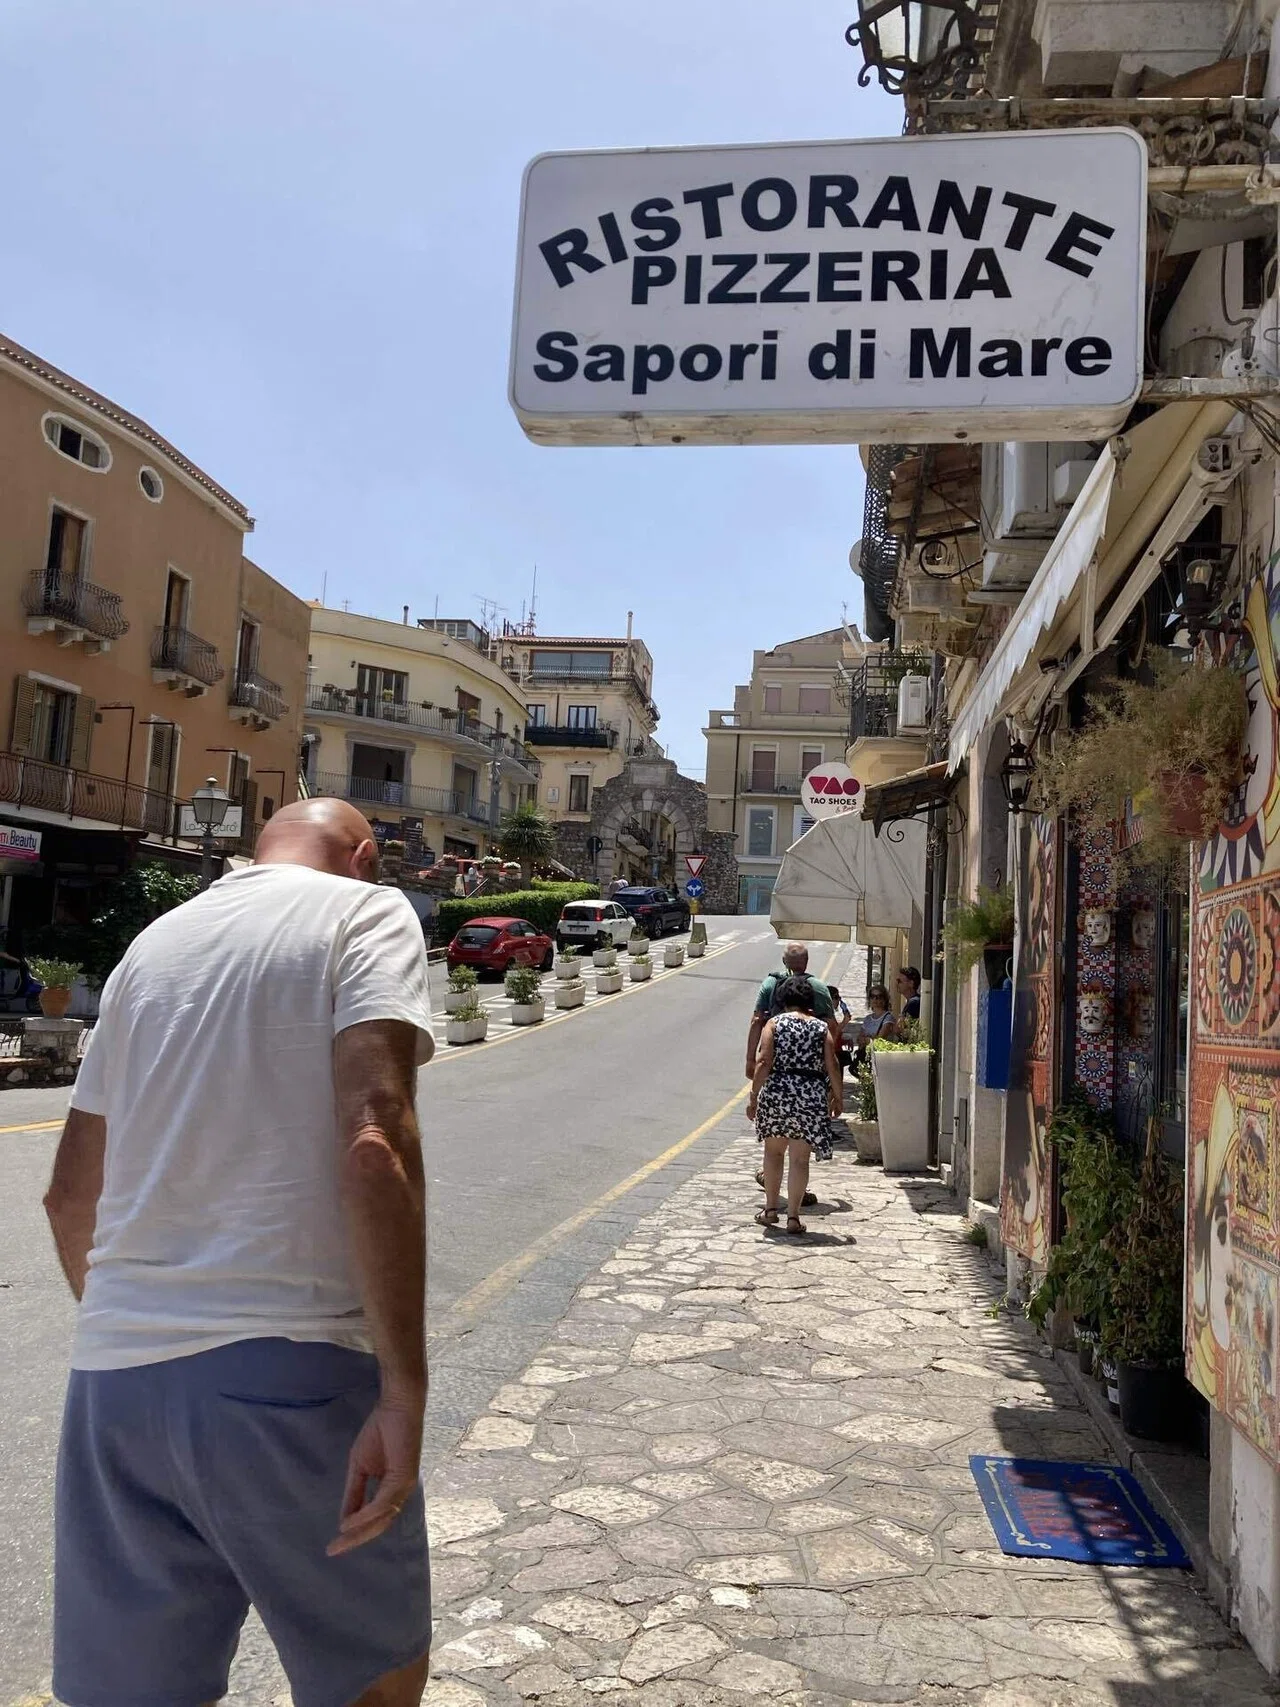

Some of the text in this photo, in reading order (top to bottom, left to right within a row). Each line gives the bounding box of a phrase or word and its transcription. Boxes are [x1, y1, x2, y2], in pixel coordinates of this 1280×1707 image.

[538, 174, 1116, 289] RISTORANTE
[631, 247, 1012, 305] PIZZERIA
[532, 326, 1113, 396] Sapori di Mare
[809, 797, 857, 806] TAO SHOES
[10, 829, 37, 851] Beauty
